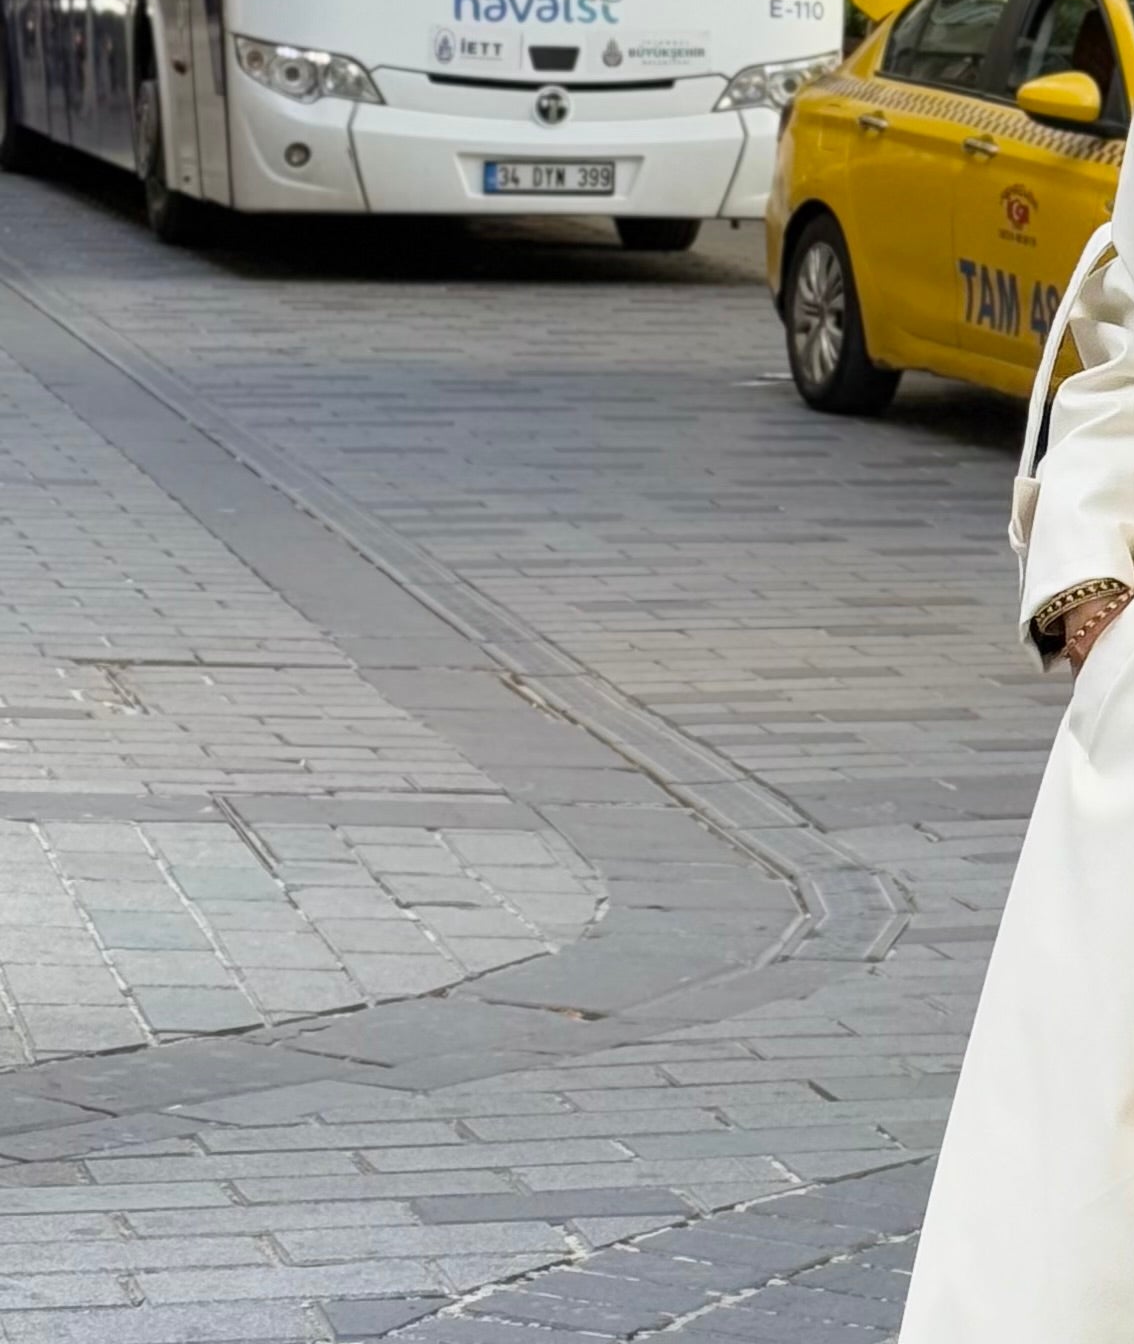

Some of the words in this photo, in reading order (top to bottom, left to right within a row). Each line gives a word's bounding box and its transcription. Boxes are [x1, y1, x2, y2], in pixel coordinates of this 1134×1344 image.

[460, 37, 503, 57] İETT
[499, 166, 520, 187] 34
[532, 166, 566, 187] DYN
[578, 167, 612, 188] 399
[958, 257, 1021, 337] TAM
